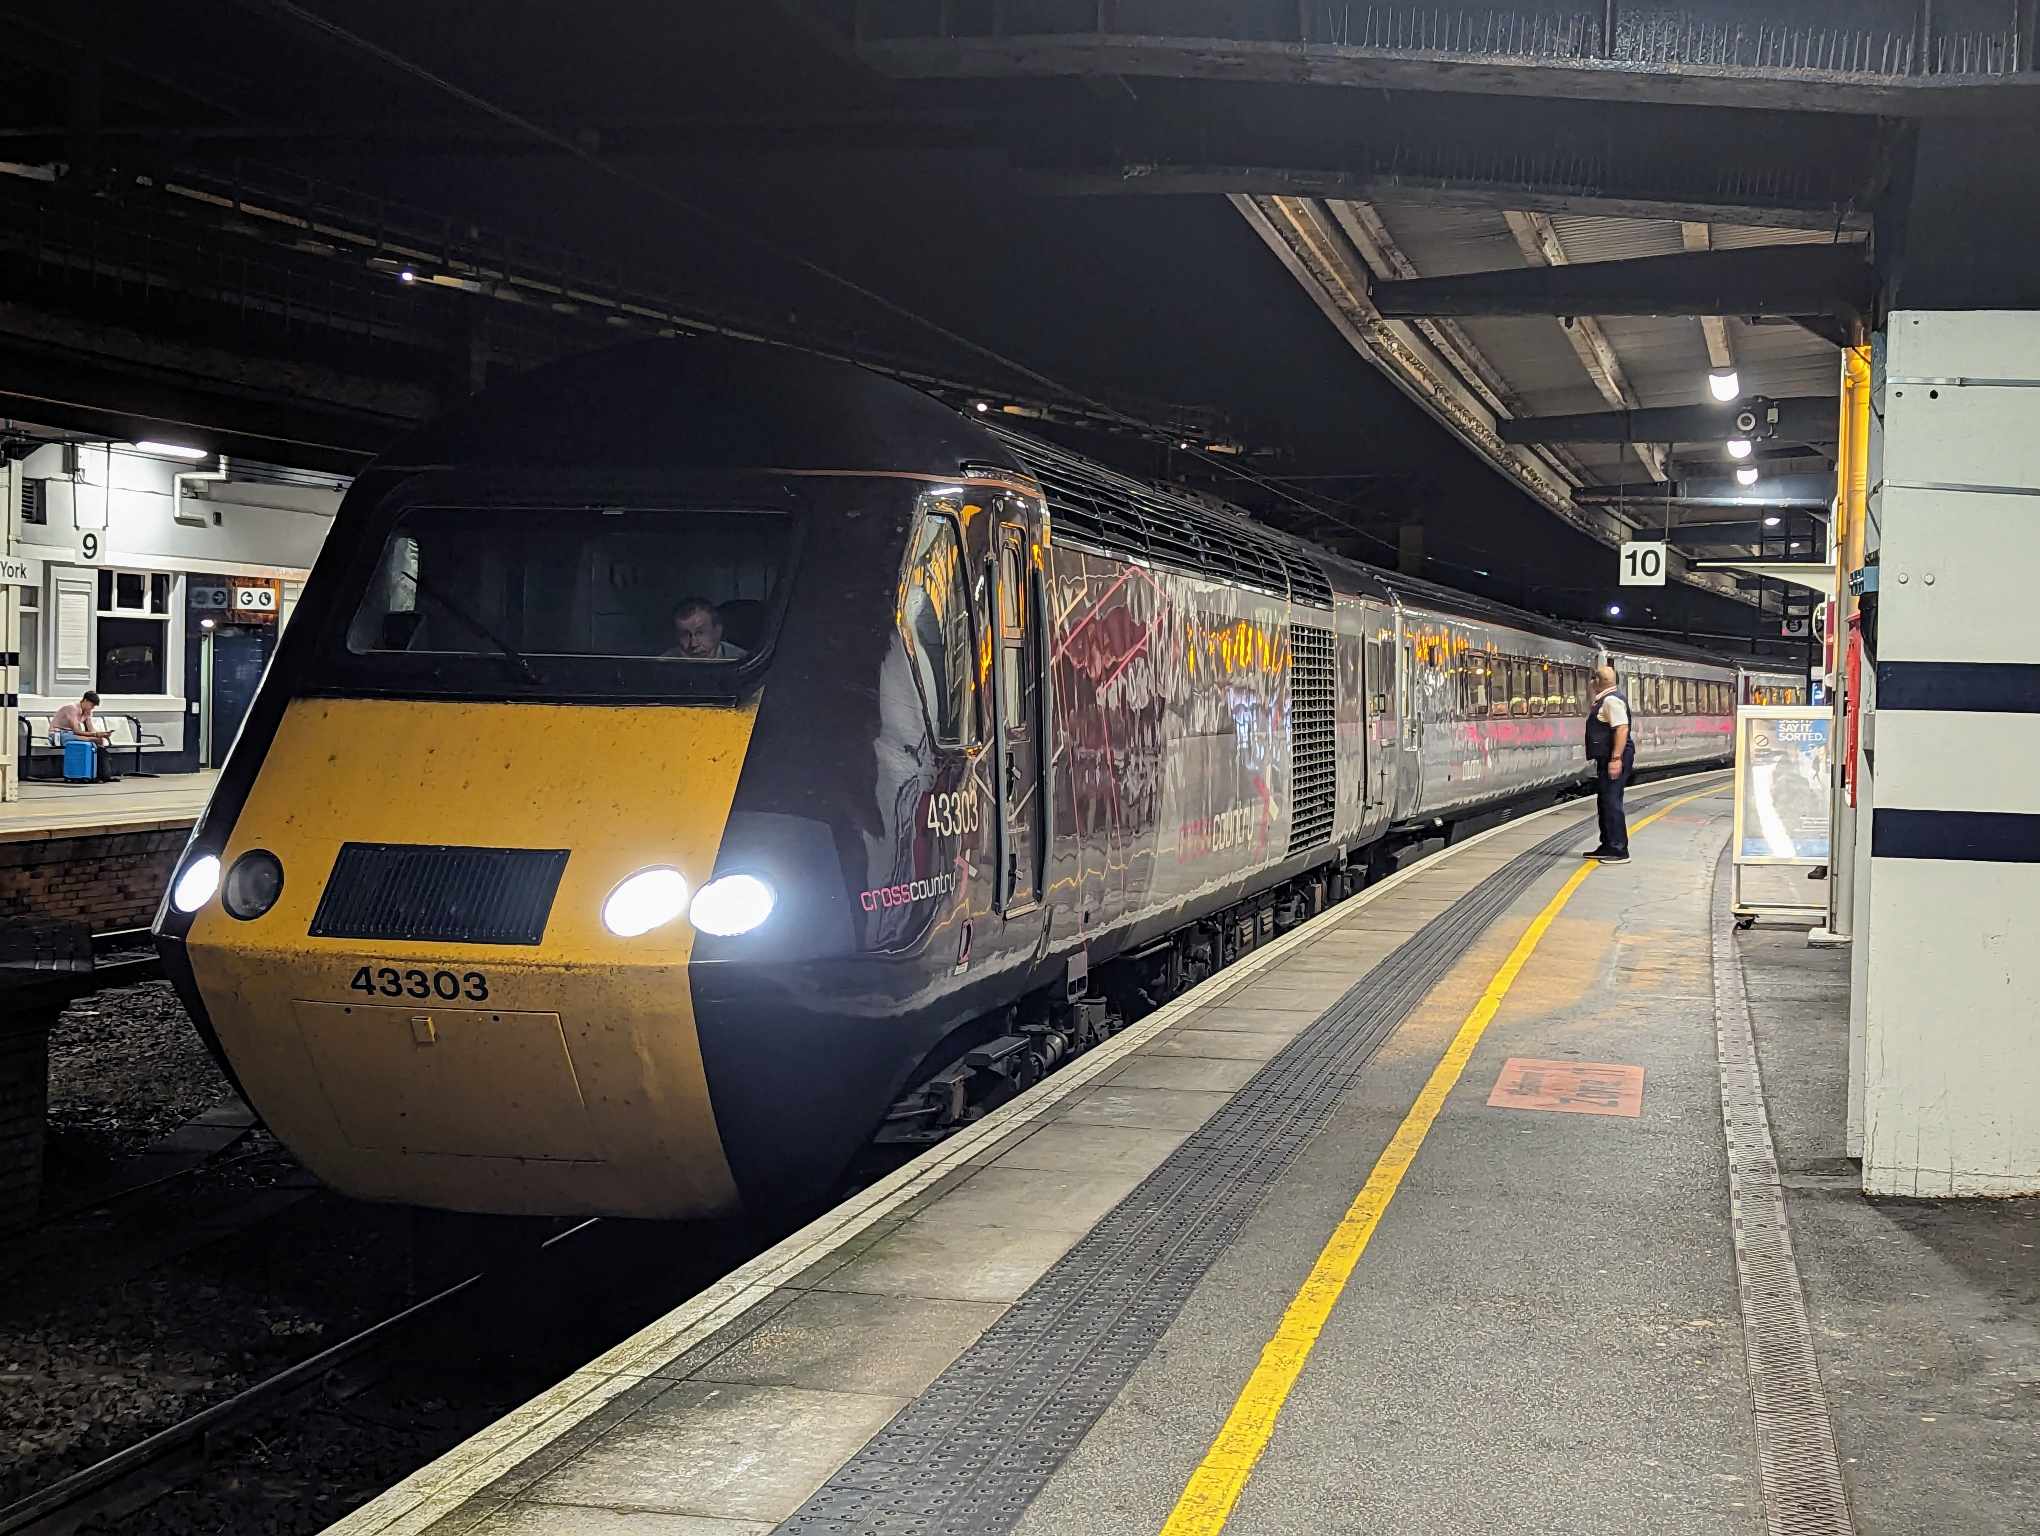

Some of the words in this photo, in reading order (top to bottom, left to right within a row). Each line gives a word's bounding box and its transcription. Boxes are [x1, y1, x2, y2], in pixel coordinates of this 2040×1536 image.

[82, 532, 98, 560] 9
[0, 561, 28, 579] York
[1624, 549, 1661, 577] 10
[1778, 723, 1800, 733] SAY
[927, 789, 979, 838] 43303
[860, 871, 957, 912] crosscountry
[350, 966, 489, 1001] 43303
